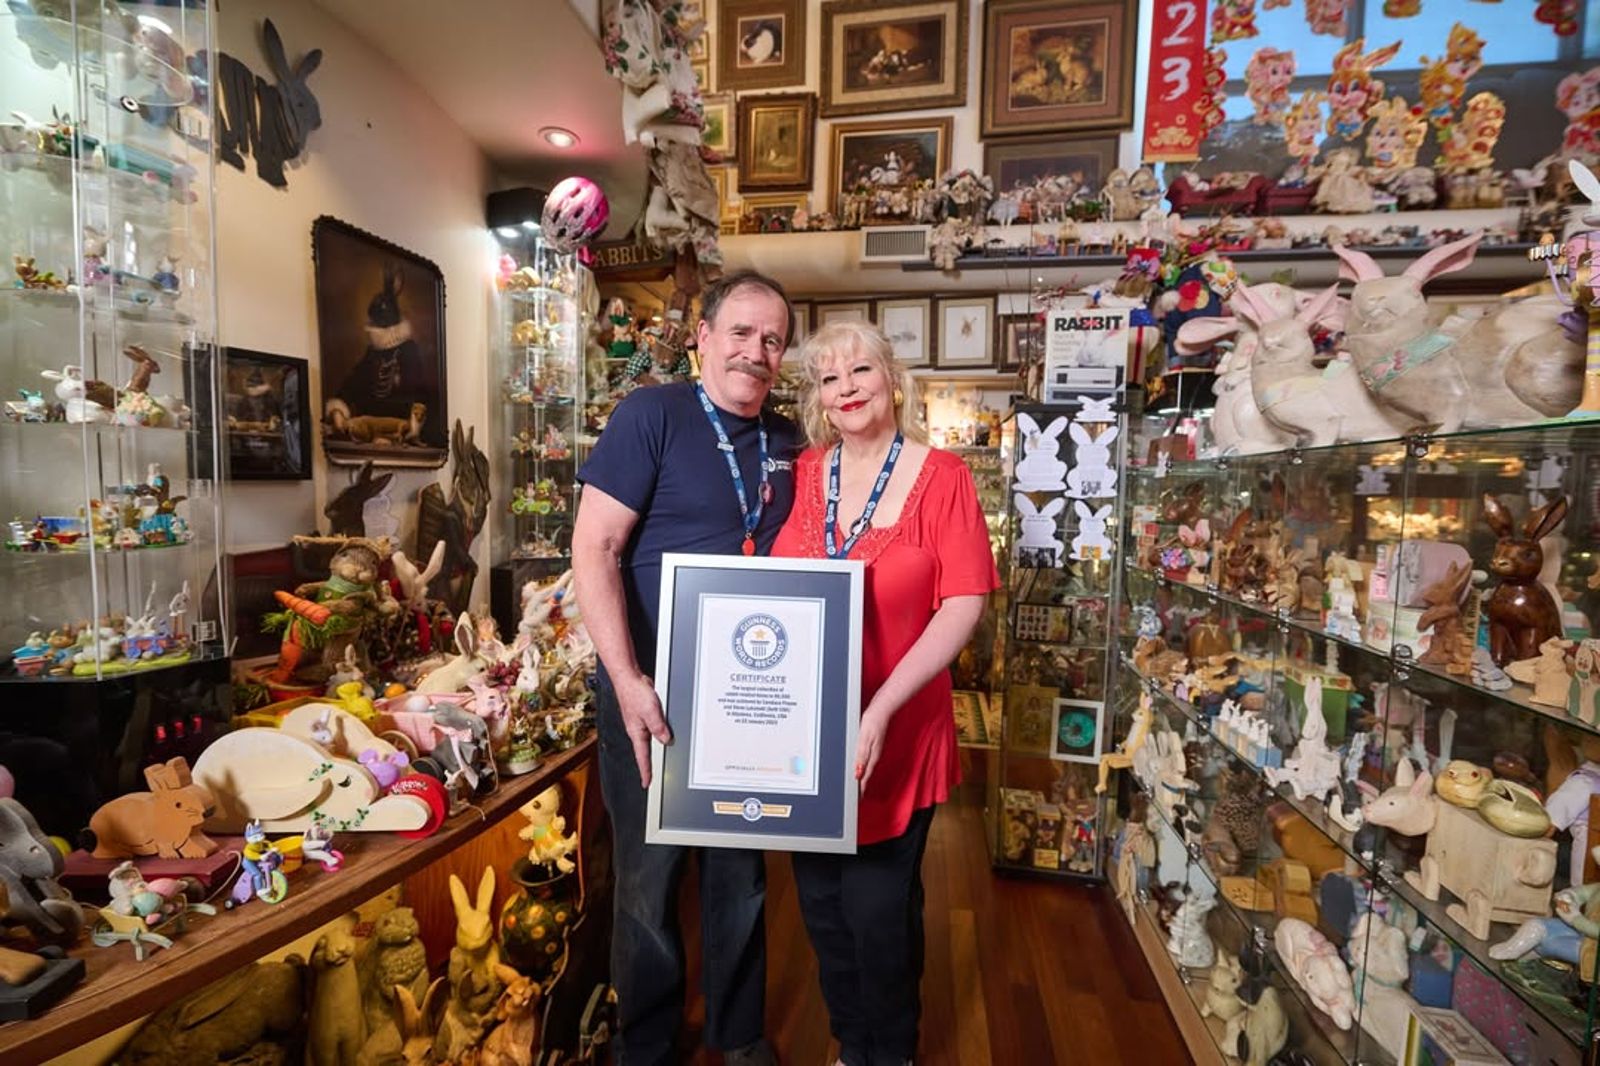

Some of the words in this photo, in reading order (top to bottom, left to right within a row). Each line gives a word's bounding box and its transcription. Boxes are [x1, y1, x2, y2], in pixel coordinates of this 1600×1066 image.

[595, 243, 663, 267] ABBITS
[1054, 316, 1123, 331] RABBIT
[740, 616, 781, 633] GUINNESS
[735, 637, 754, 666] WORLD
[754, 639, 785, 667] RECORDS
[730, 673, 786, 684] CERTIFICATE
